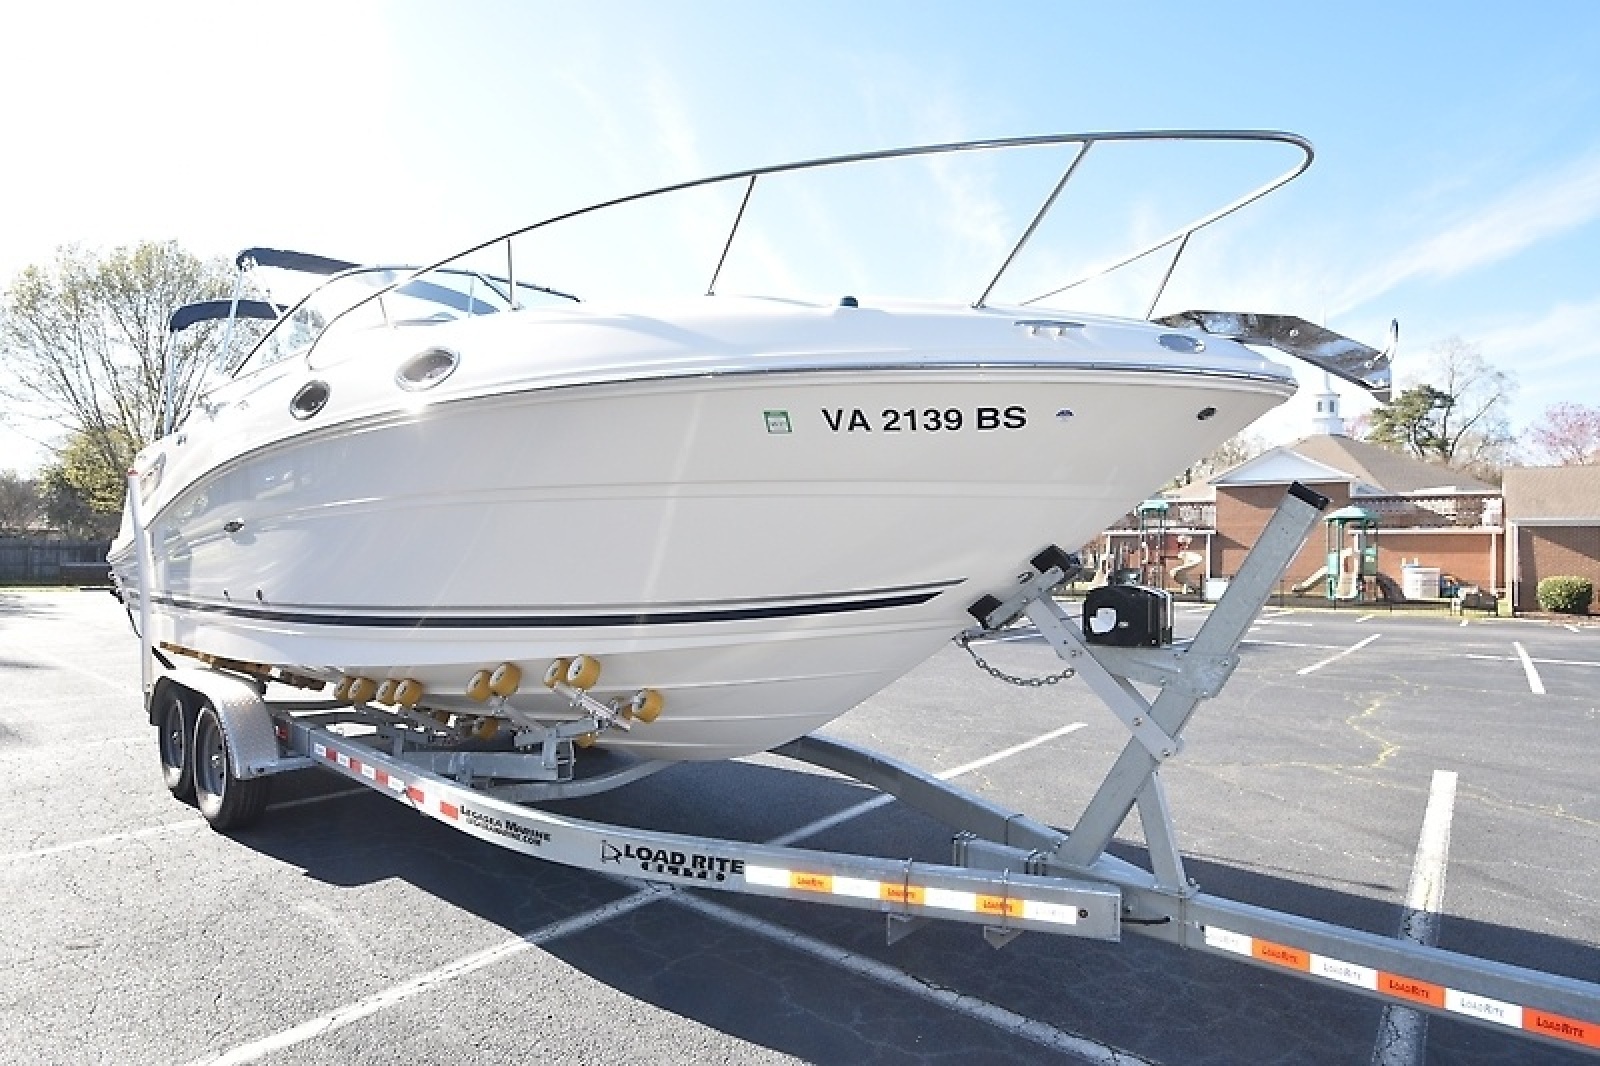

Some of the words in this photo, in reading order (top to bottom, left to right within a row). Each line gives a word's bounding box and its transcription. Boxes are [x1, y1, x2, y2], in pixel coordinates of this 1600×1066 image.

[821, 408, 872, 432] VA
[881, 409, 964, 432] 2139
[976, 406, 1028, 431] BS
[624, 843, 686, 864] LOAD
[691, 853, 746, 874] RITE
